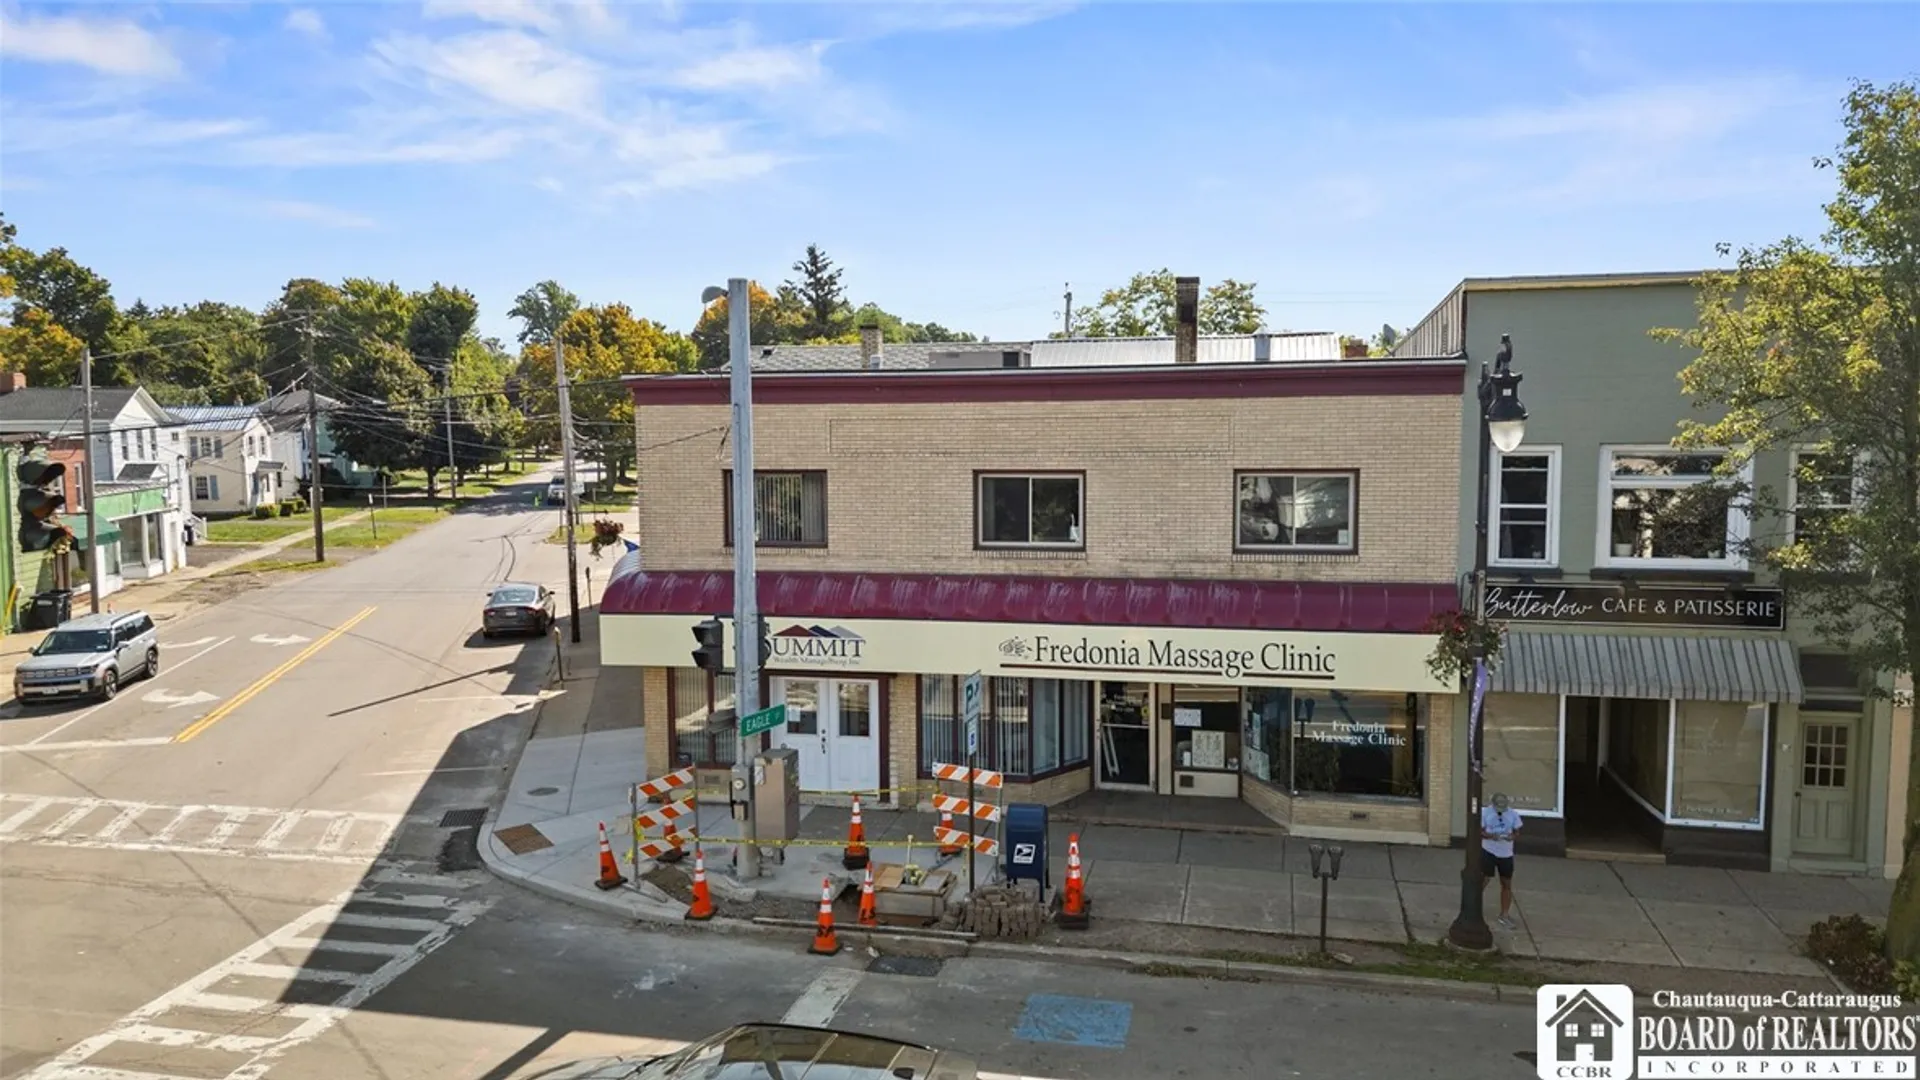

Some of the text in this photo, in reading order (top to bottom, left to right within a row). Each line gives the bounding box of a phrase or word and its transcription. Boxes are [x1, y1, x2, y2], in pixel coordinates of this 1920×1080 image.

[1485, 587, 1776, 618] Butterlow CAFE & PATISSERIE
[771, 637, 866, 657] UMMIT
[1034, 635, 1336, 678] Fredonia Massage Clinic
[746, 712, 771, 732] EAGLE
[1332, 720, 1385, 733] Fredonia
[1312, 730, 1407, 747] Massage Clinic
